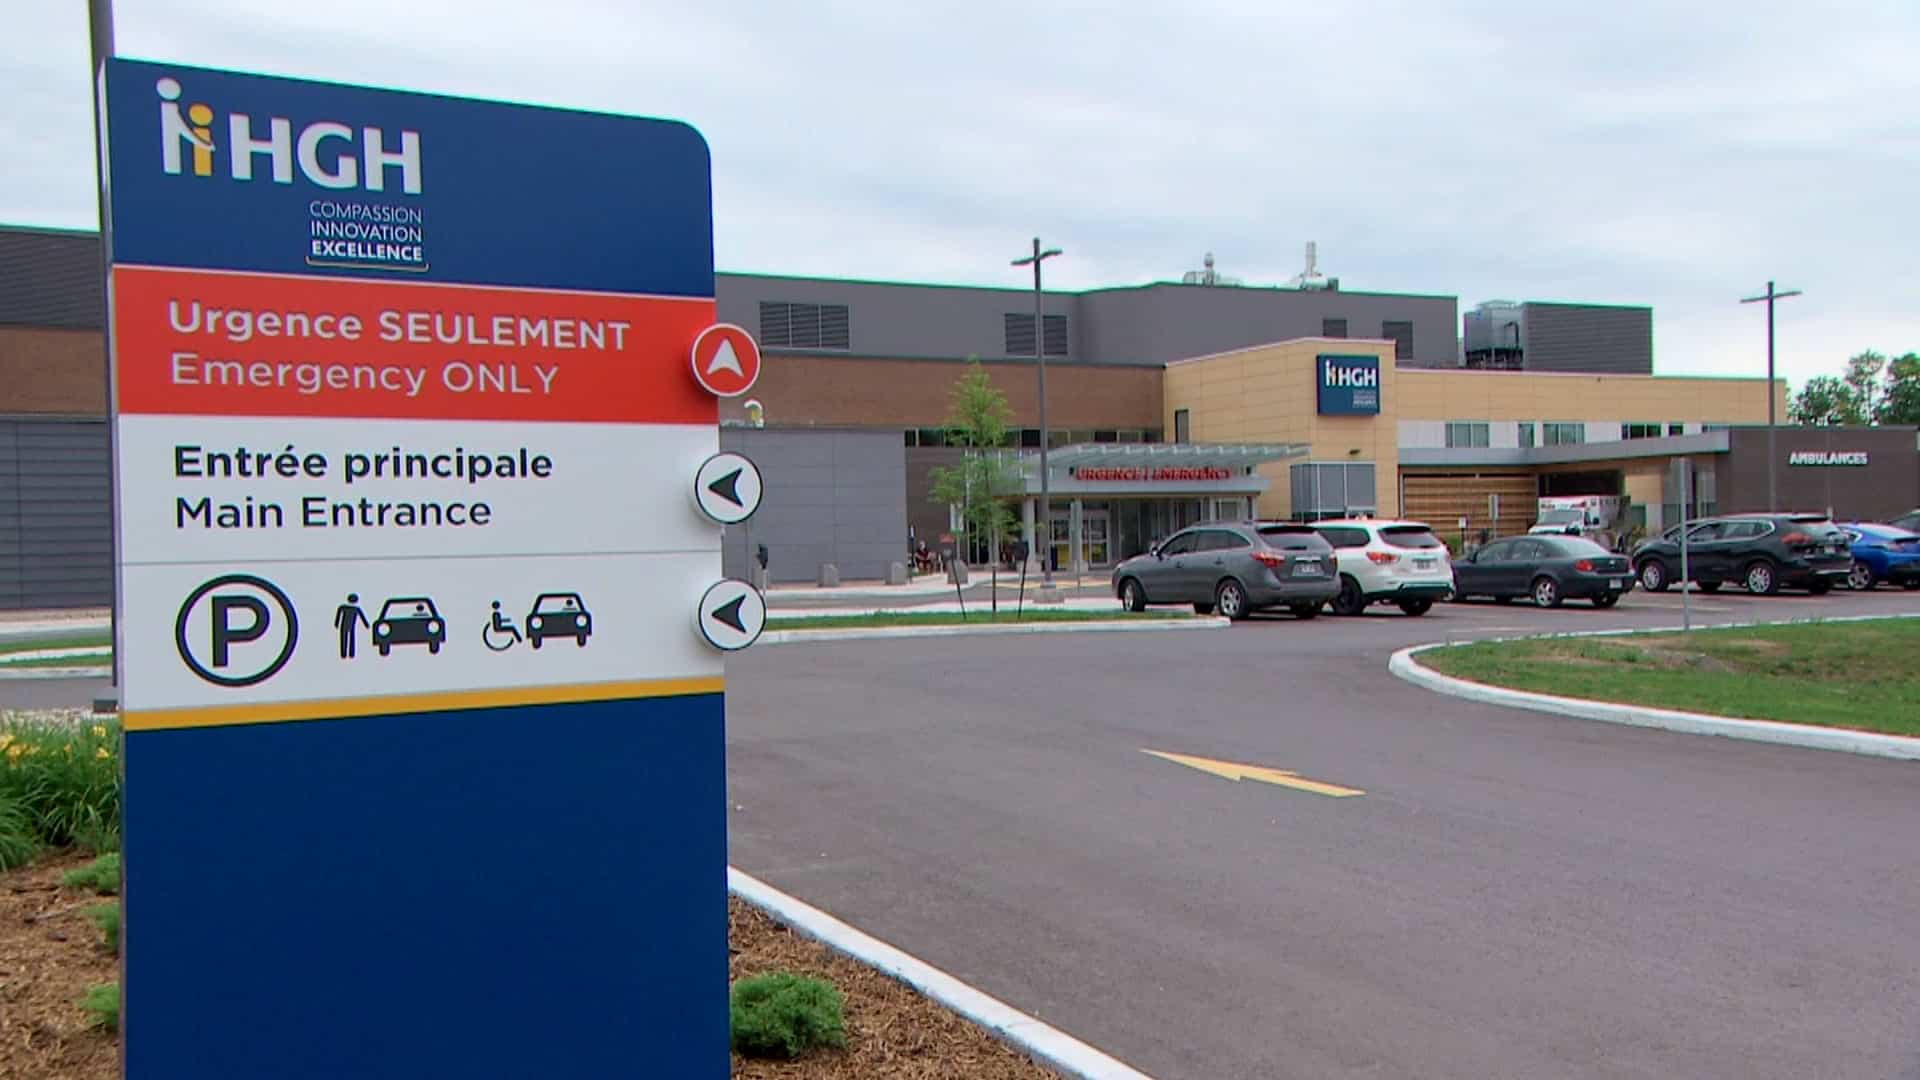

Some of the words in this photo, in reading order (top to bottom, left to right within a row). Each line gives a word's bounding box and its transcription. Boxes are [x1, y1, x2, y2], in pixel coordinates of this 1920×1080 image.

[309, 200, 422, 223] COMPASSION
[311, 220, 422, 242] INNOVATION
[311, 239, 423, 261] EXCELLENCE
[168, 300, 363, 342] Urgence
[378, 310, 631, 350] SEULEMENT
[171, 352, 427, 397] Emergency
[441, 361, 560, 395] ONLY
[174, 445, 328, 478] Entrée
[344, 446, 553, 483] principale
[1789, 451, 1868, 465] AMBULANCES
[176, 496, 283, 528] Main
[301, 496, 492, 527] Entrance
